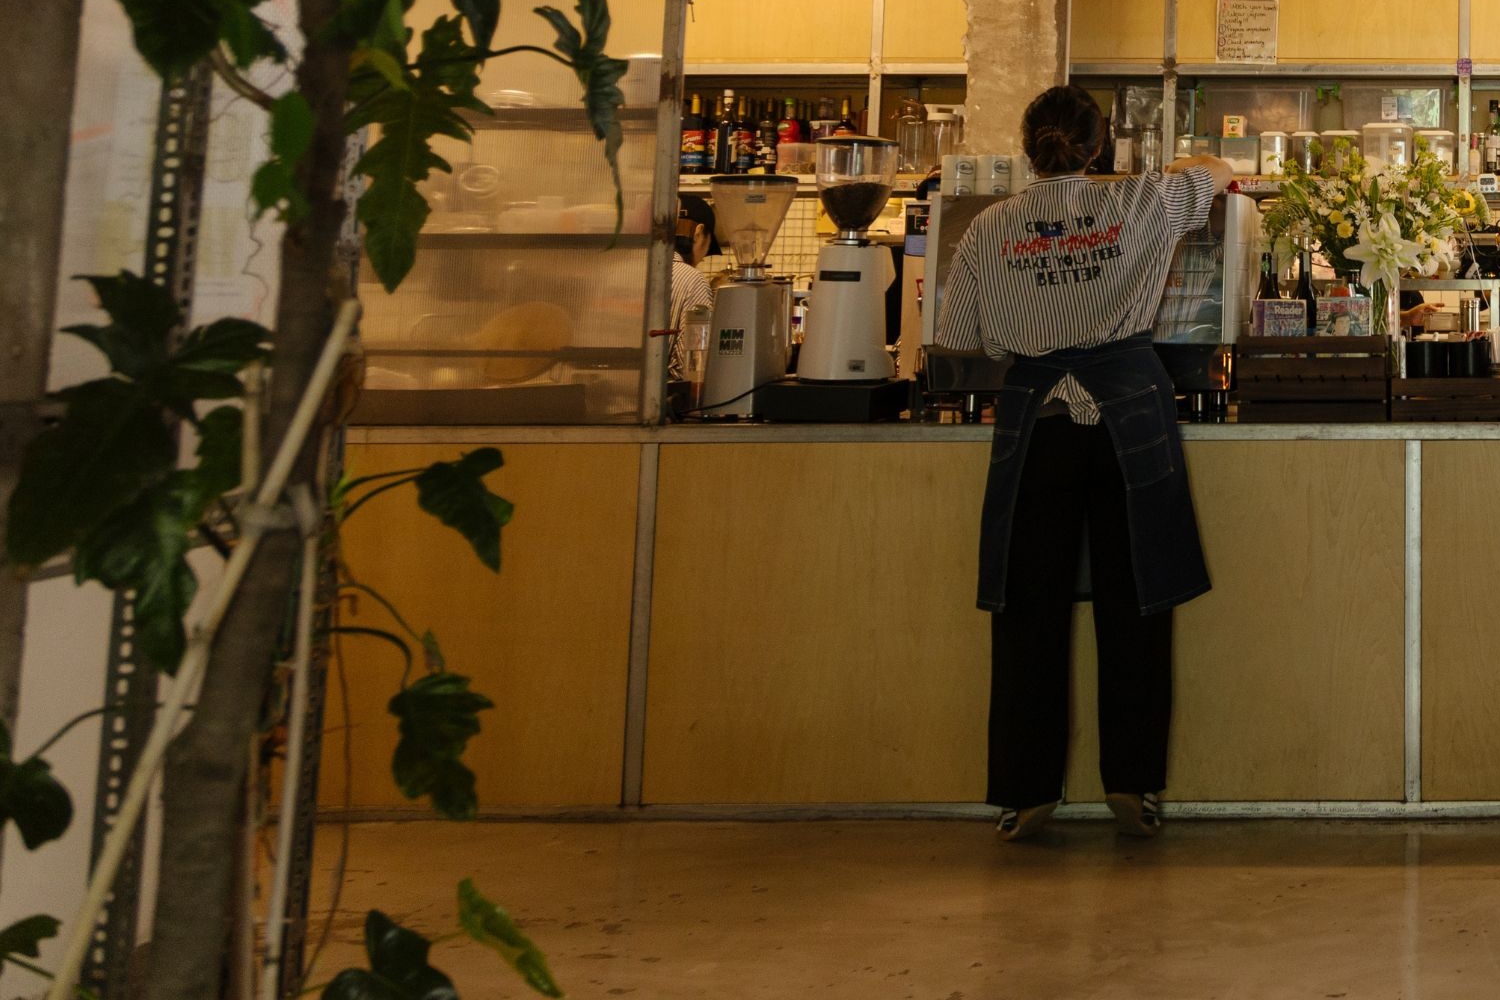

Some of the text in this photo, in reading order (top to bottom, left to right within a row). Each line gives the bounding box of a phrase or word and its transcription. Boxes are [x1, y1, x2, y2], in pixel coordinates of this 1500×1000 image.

[1075, 216, 1095, 229] TO
[1007, 245, 1124, 272] MAKE YOU FEEL
